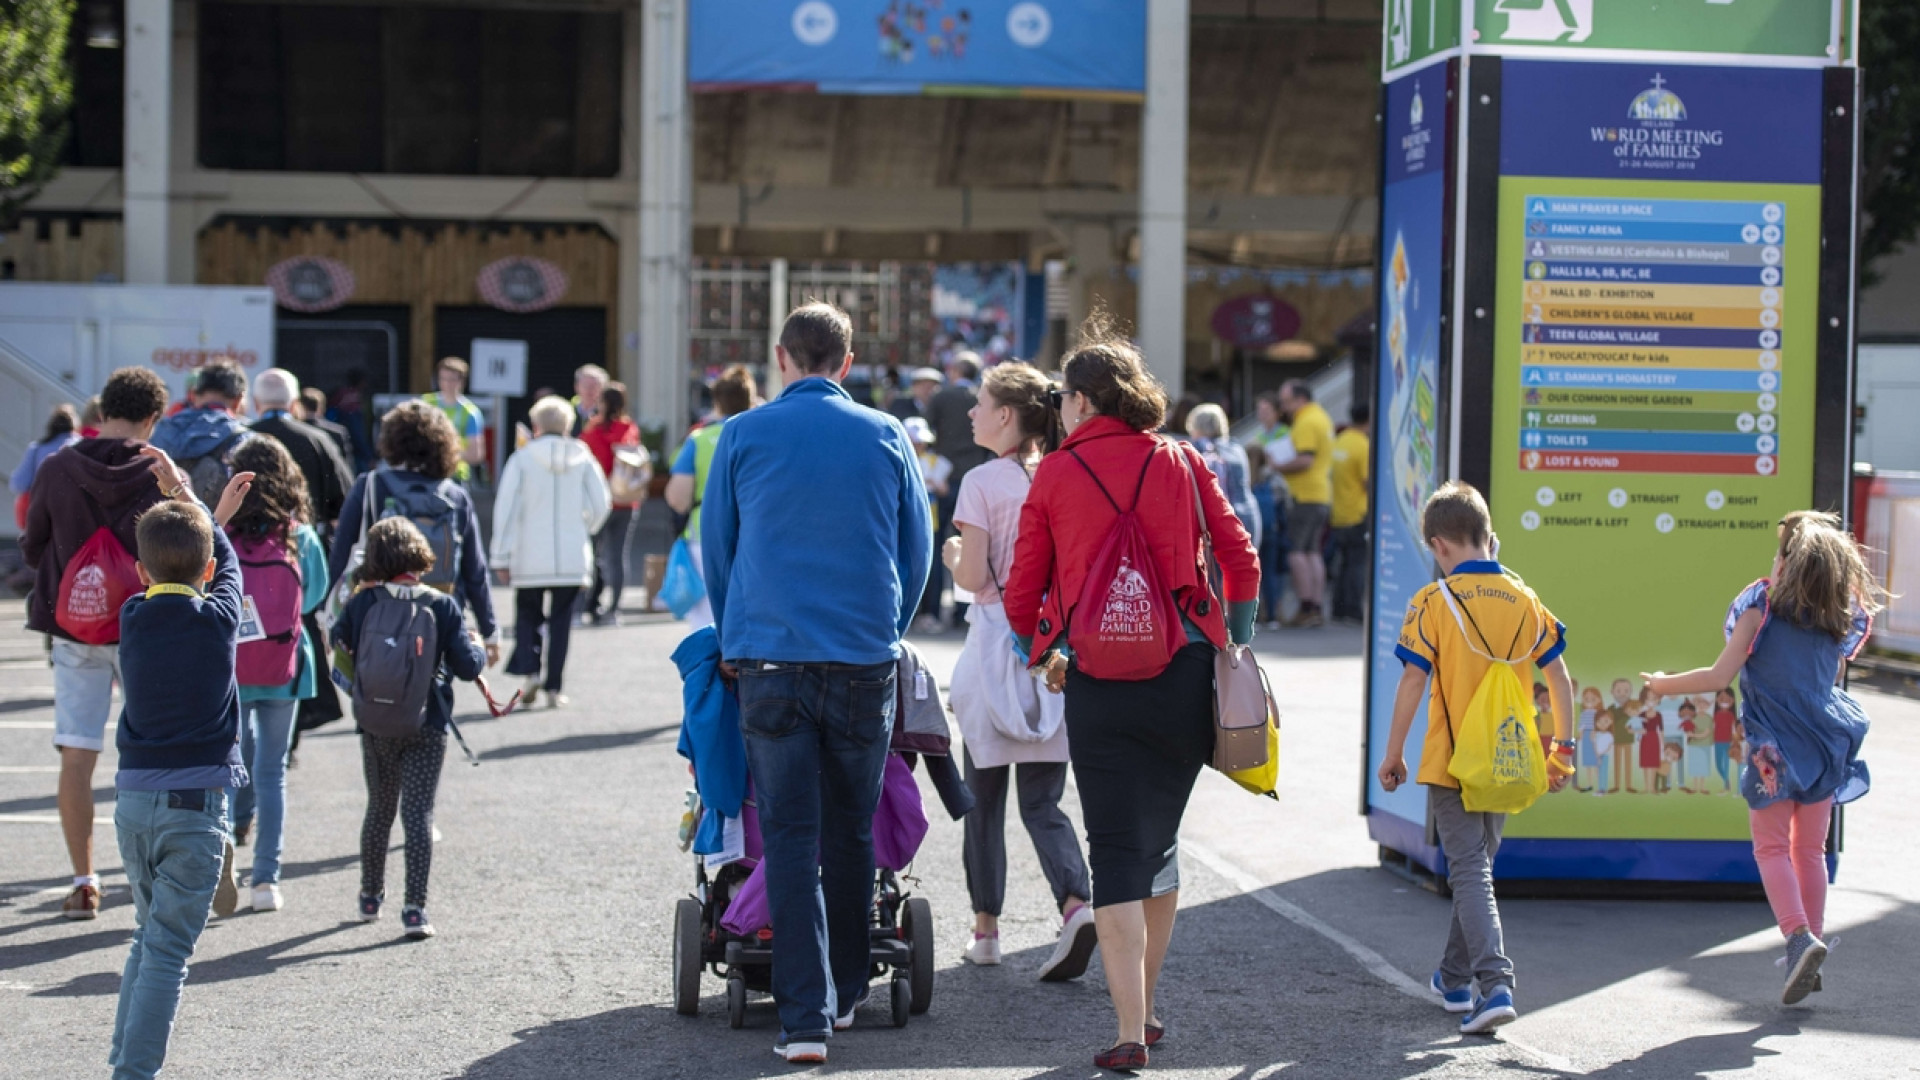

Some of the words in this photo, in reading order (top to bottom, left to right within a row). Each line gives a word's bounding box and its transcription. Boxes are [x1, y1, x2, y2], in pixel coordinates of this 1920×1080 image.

[1640, 120, 1675, 128] IRELAND
[1590, 127, 1649, 143] WORLD
[1652, 129, 1723, 146] MEETING
[1613, 143, 1629, 157] of
[1632, 143, 1701, 159] FAMILIES
[1643, 160, 1674, 169] AUGUST
[1551, 202, 1578, 213] MAIN
[1581, 203, 1620, 214] PRAYER
[1621, 205, 1653, 216] SPACE
[1551, 224, 1587, 235] FAMILY
[1588, 225, 1623, 236] ARENA
[1550, 245, 1594, 257] VESTING
[1595, 246, 1623, 258] AREA
[1624, 246, 1675, 259] (Cardinals
[1677, 250, 1685, 258] &
[1686, 248, 1730, 261] Bishops)
[1550, 266, 1583, 277] HALLS
[1585, 267, 1600, 279] 8A,
[1621, 268, 1637, 280] 8C,
[1550, 287, 1575, 298] HALL
[1578, 288, 1592, 298] 8D
[1549, 308, 1611, 319] CHILDREN'S
[1613, 310, 1651, 320] GLOBAL
[1653, 311, 1695, 322] VILLAGE
[1549, 329, 1575, 341] TEEN
[1576, 330, 1617, 342] GLOBAL
[1619, 331, 1660, 343] VILLAGE
[1548, 351, 1629, 363] YOUCAT/YOUCAT
[1632, 352, 1646, 363] for
[1648, 352, 1670, 364] kids
[488, 357, 509, 378] IN
[1549, 371, 1563, 382] ST.
[1565, 372, 1614, 384] DAMIAN'S
[1615, 373, 1678, 386] MONASTERY
[1547, 393, 1570, 403] OUR
[1571, 394, 1617, 404] COMMON
[1619, 395, 1650, 405] HOME
[1652, 395, 1693, 406] GARDEN
[1546, 413, 1597, 425] CATERING
[1546, 434, 1588, 446] TOILETS
[1545, 456, 1572, 467] LOST
[1573, 456, 1580, 467] &
[1583, 457, 1620, 468] FOUND
[1558, 491, 1582, 502] LEFT
[1630, 494, 1679, 504] STRAIGHT
[1728, 495, 1757, 506] RIGHT
[1543, 516, 1592, 526] STRAIGHT
[1594, 517, 1602, 527] &
[1604, 517, 1629, 528] LEFT
[1677, 519, 1726, 530] STRAIGHT
[1728, 520, 1736, 530] &
[1738, 520, 1769, 530] RIGHT
[1106, 600, 1151, 614] WORLD
[1100, 621, 1153, 634] FAMILIES
